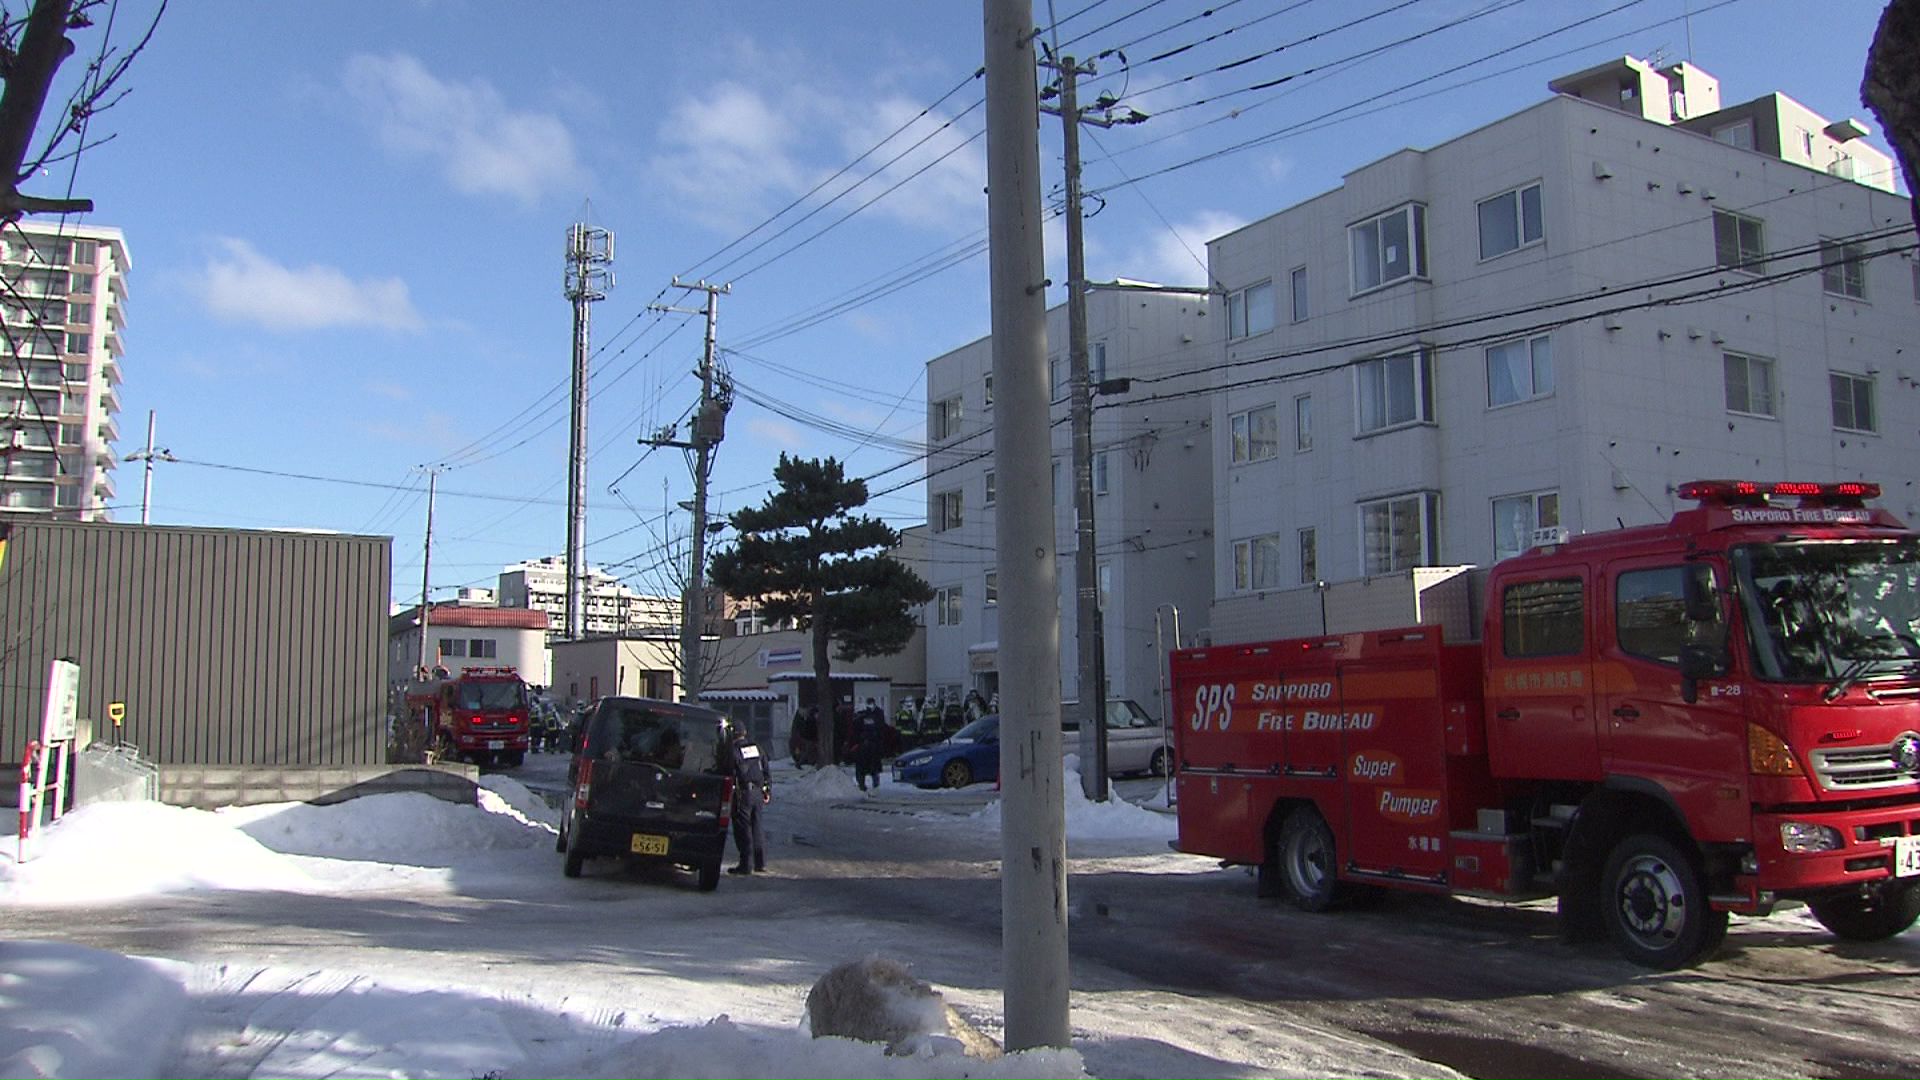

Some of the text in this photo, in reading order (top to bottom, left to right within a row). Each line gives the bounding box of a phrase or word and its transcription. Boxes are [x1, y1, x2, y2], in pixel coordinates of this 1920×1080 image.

[1251, 682, 1332, 701] SAPPORO
[1191, 683, 1236, 731] SPS
[1353, 754, 1396, 779] Super
[1380, 791, 1439, 818] Pumper
